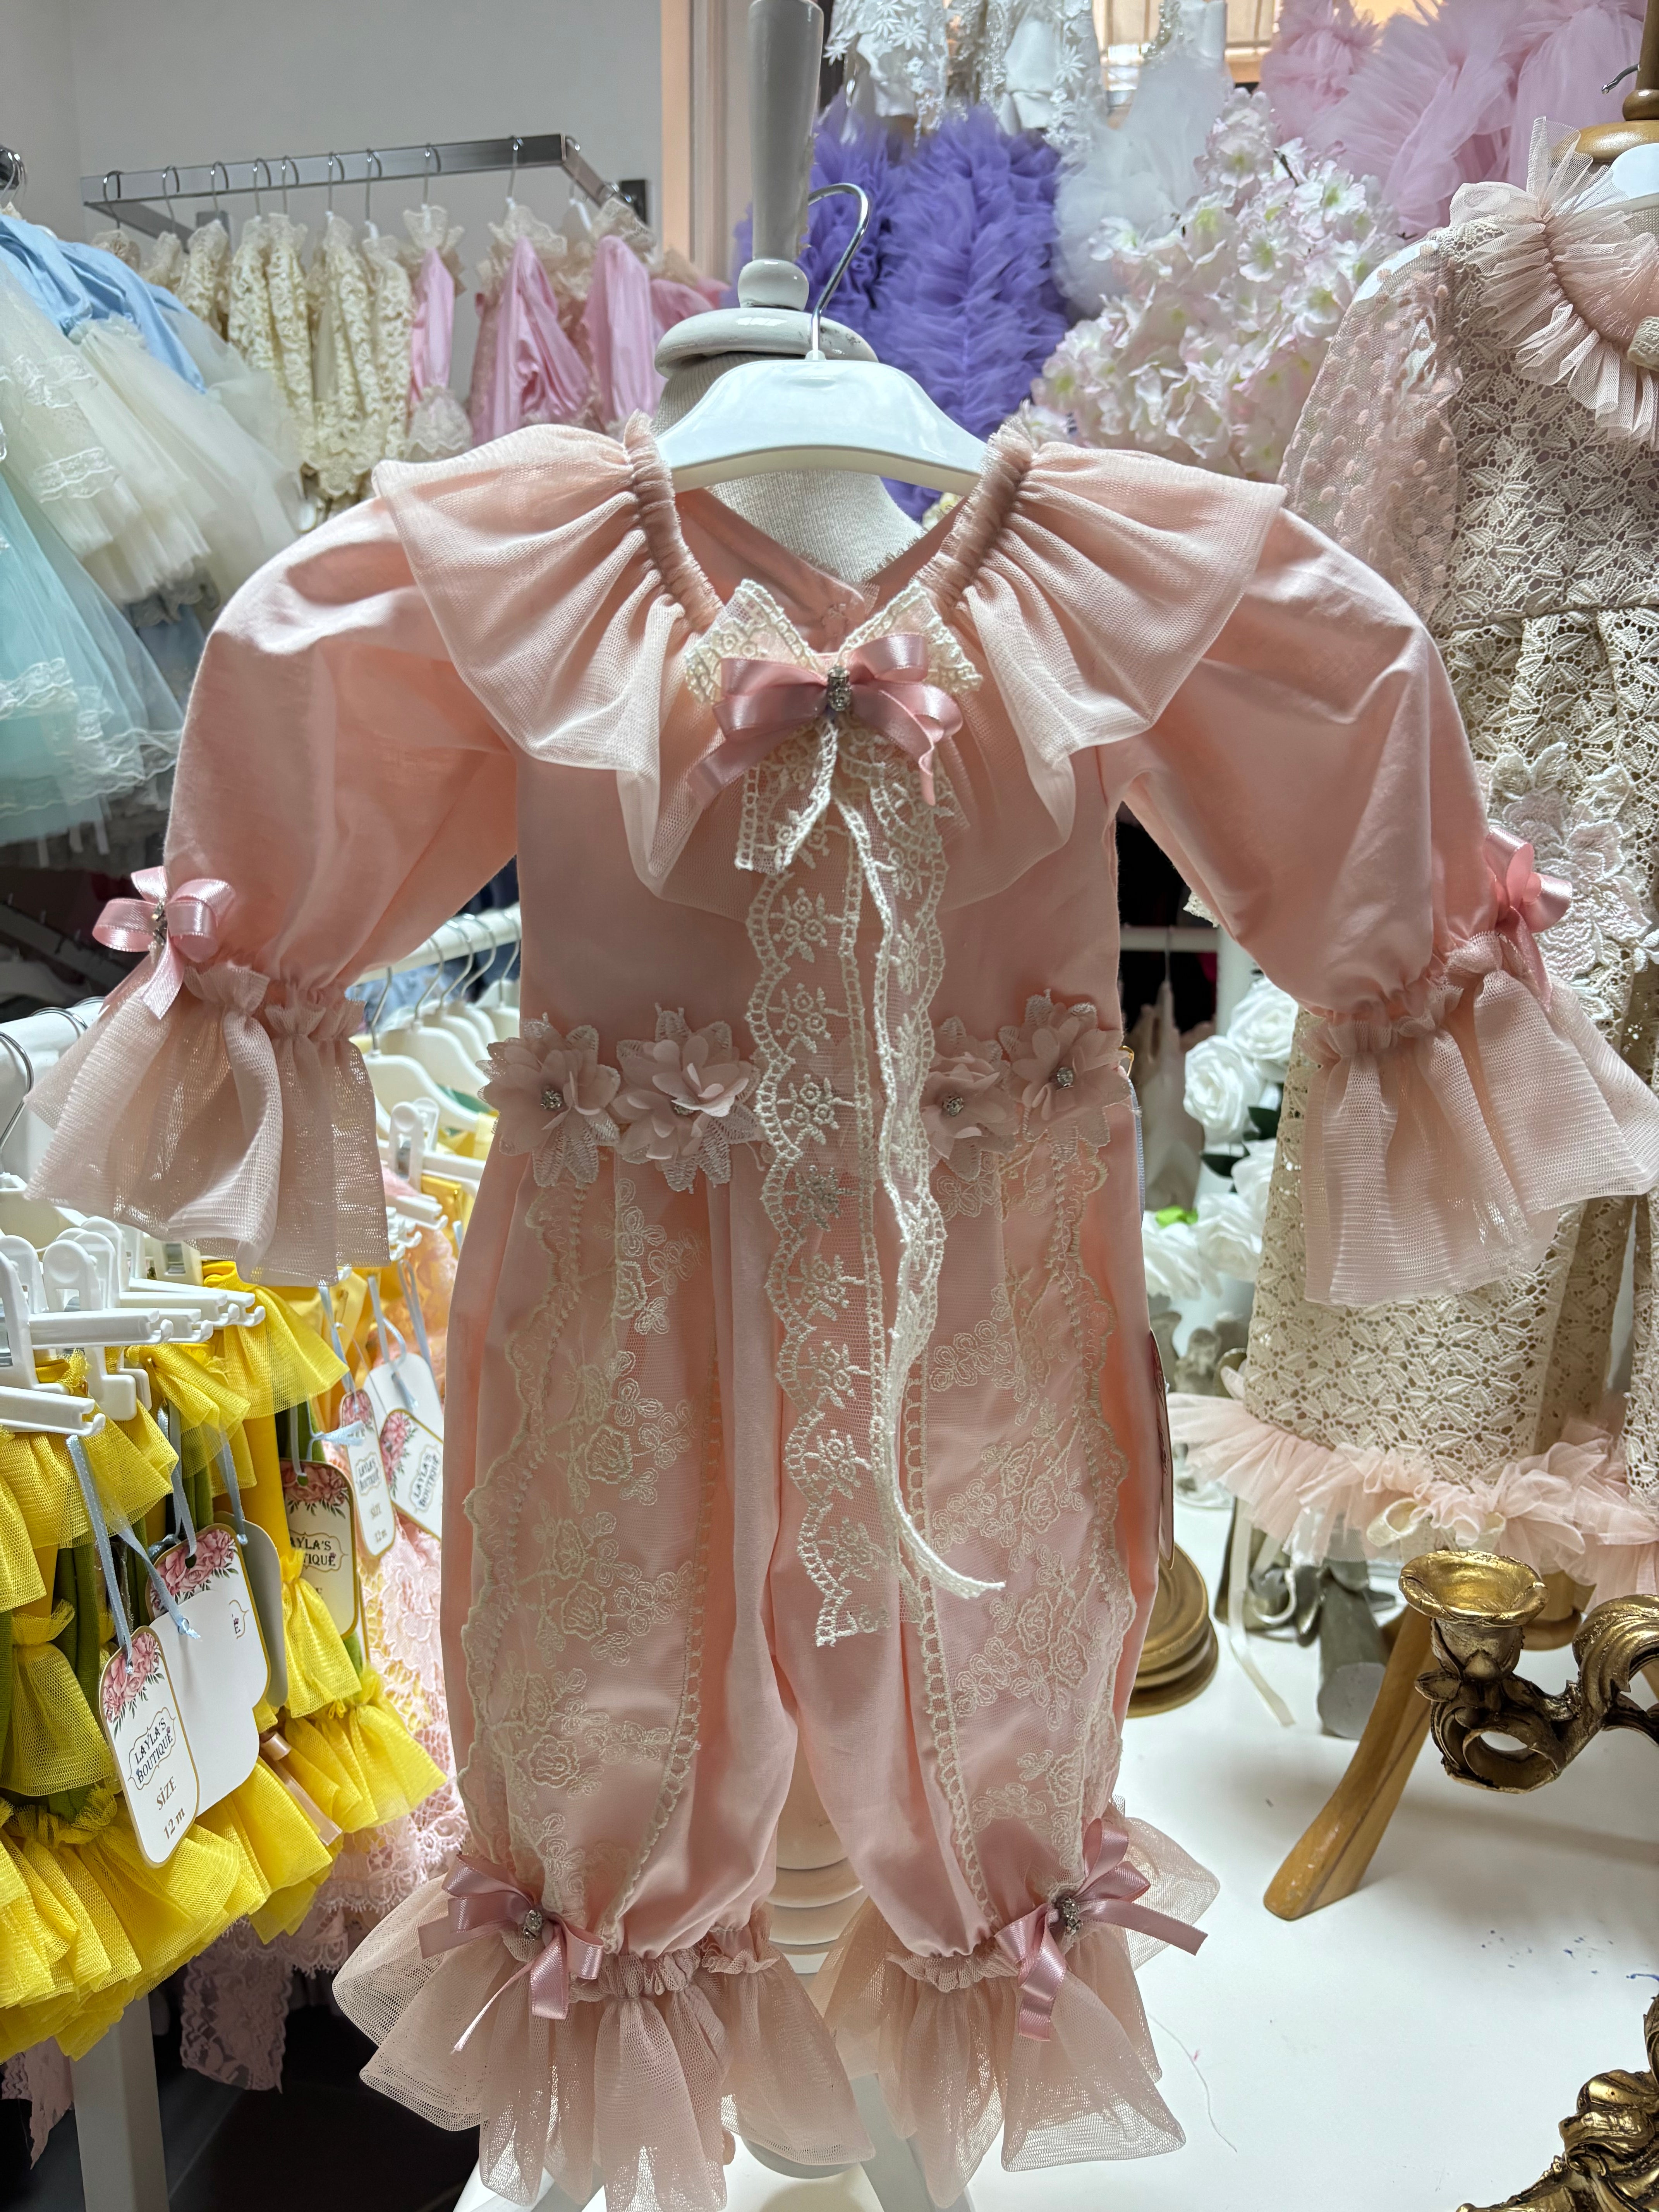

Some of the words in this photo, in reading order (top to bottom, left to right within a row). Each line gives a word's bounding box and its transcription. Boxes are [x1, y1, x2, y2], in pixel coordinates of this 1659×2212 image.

[290, 1536, 331, 1551] AYLA'S
[303, 1553, 336, 1566] TIQUE
[134, 1717, 166, 1765] LAYLA'S
[136, 1732, 173, 1784] BOUTIQUE
[163, 1818, 175, 1840] 12
[175, 1808, 185, 1825] m
